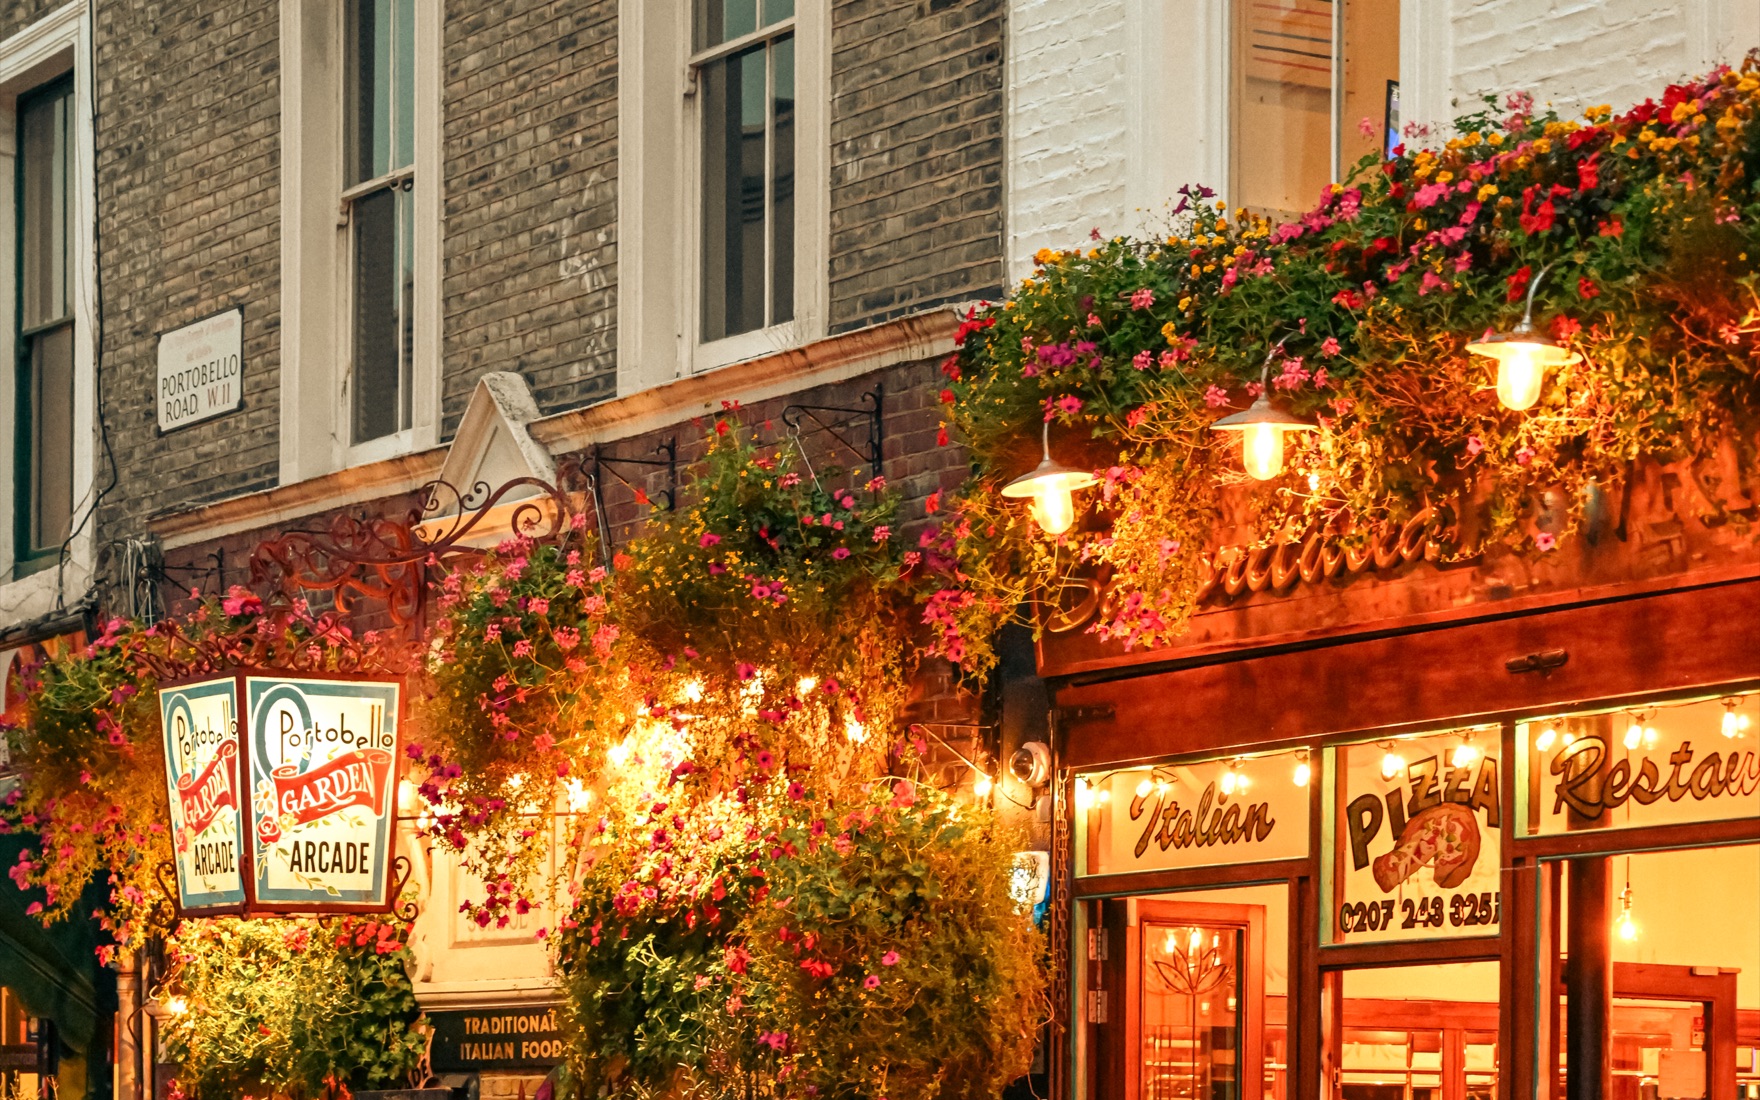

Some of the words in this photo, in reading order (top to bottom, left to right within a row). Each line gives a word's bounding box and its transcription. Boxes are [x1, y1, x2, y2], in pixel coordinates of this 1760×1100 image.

[161, 353, 238, 399] PORTOBELLO
[177, 700, 239, 774] Portobello
[280, 704, 394, 764] Portobello
[183, 757, 231, 828] GARDEN
[281, 761, 375, 815] GARDEN
[1129, 780, 1276, 859] Italian
[194, 840, 236, 877] ARCADE
[289, 840, 370, 875] ARCADE
[1339, 899, 1396, 934] 0207
[1401, 896, 1445, 930] 243
[463, 1014, 558, 1035] TRADITIONAL
[459, 1042, 515, 1061] ITALIAN
[521, 1039, 563, 1060] FOOD
